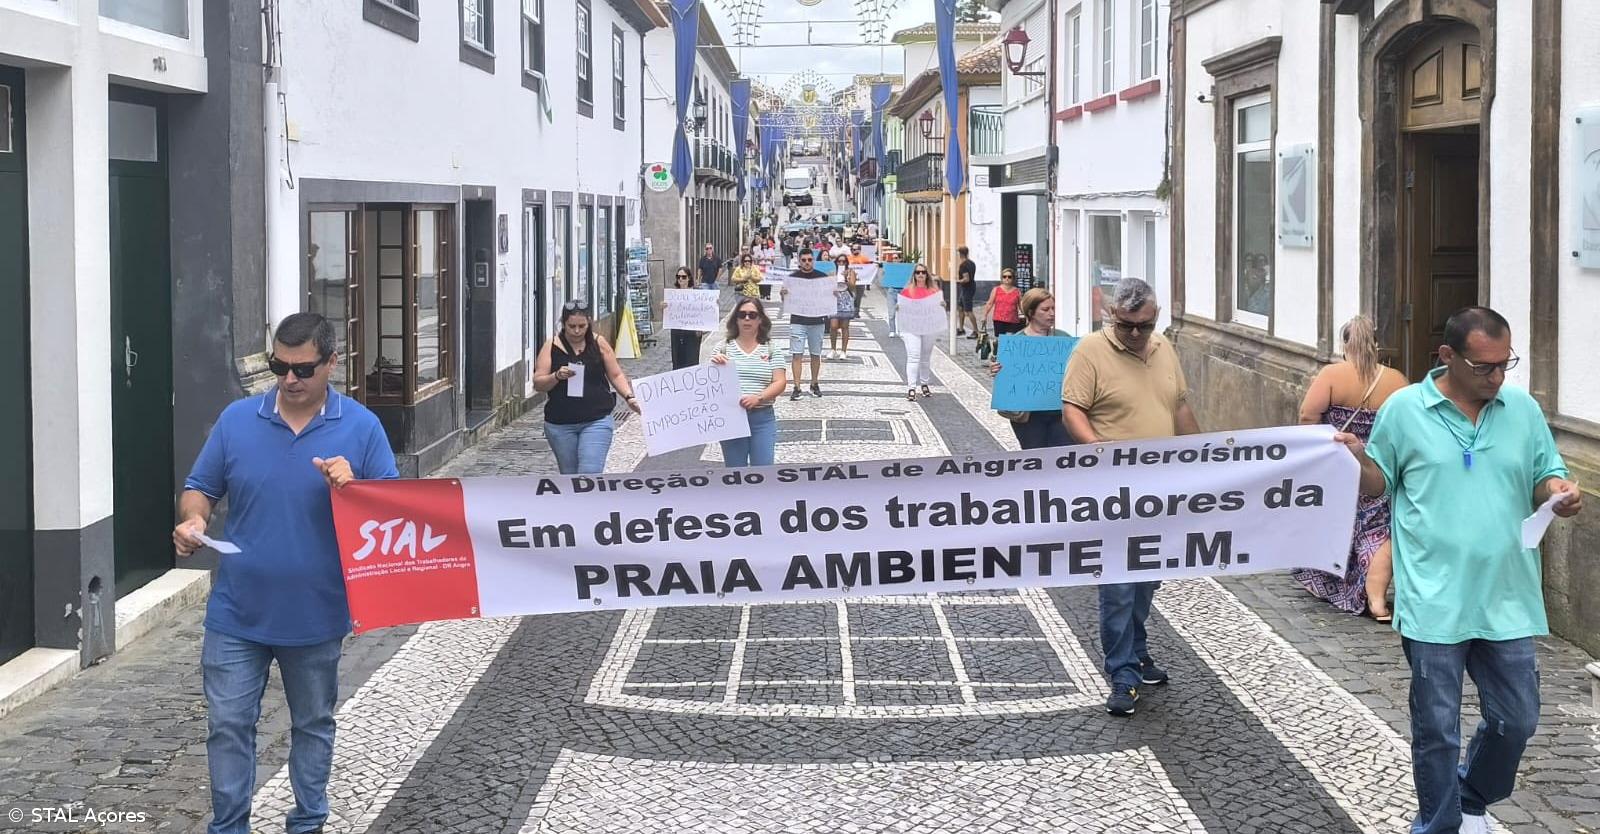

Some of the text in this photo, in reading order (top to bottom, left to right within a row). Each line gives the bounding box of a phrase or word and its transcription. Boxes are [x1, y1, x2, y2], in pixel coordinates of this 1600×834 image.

[1013, 360, 1065, 377] SALARI
[694, 383, 724, 402] SIM
[697, 416, 725, 433] NÃO
[535, 441, 1288, 496] A Direção do STAL de Angra do Heroísmo
[497, 478, 1325, 549] Em defesa dos trabalhadores da
[352, 518, 448, 561] STAL
[346, 570, 389, 581] Administração
[412, 564, 438, 572] Regional
[347, 564, 377, 574] Sindicato
[417, 557, 458, 565] Trabalhadores
[573, 531, 1250, 601] PRAIA AMBIENTE E.M.
